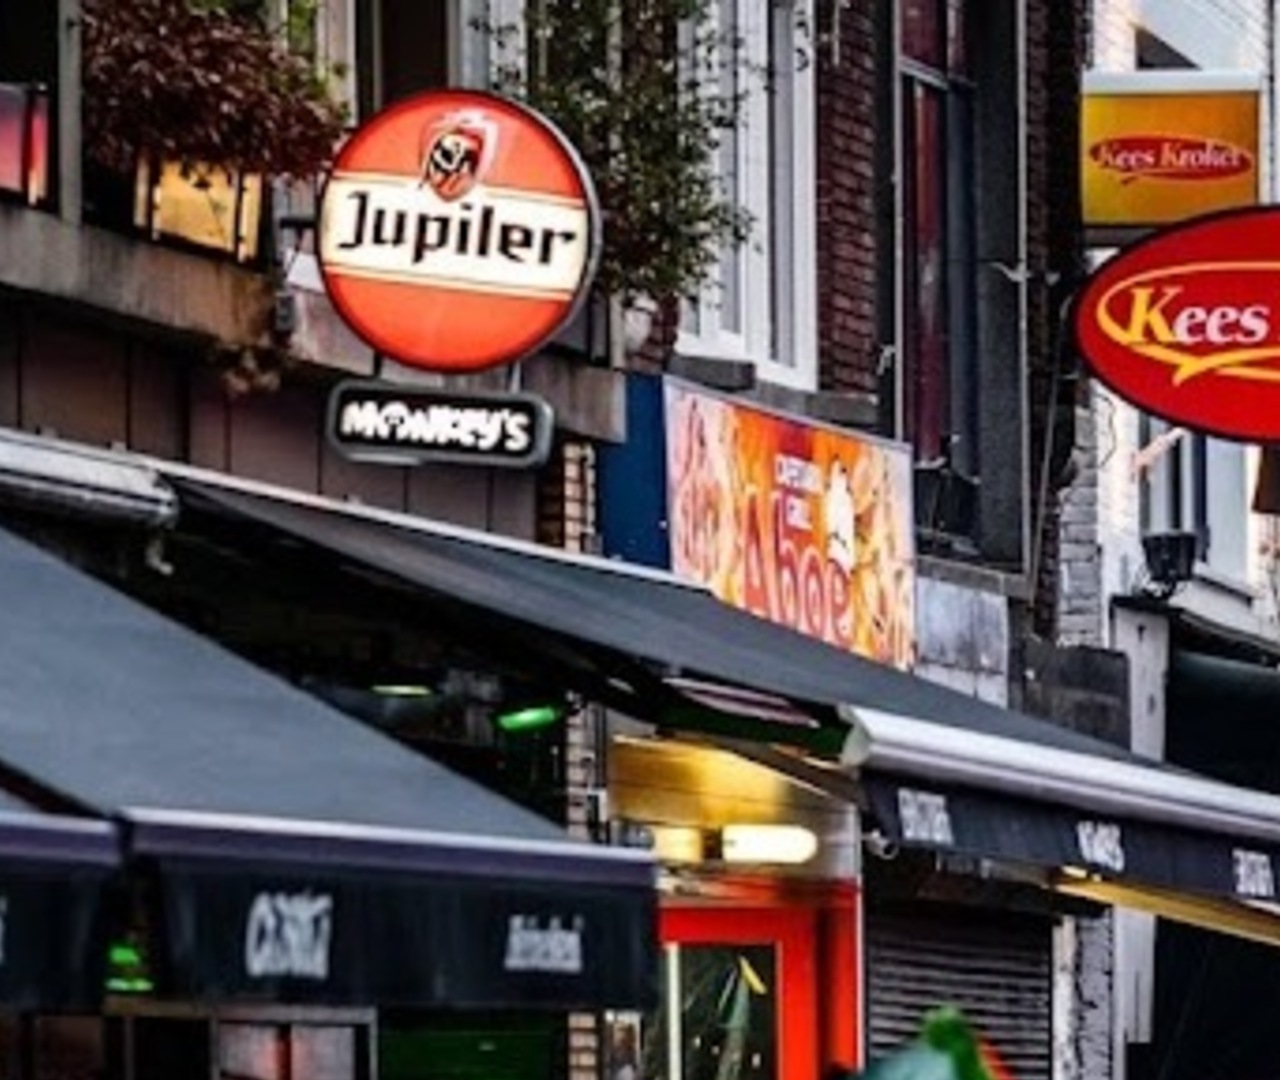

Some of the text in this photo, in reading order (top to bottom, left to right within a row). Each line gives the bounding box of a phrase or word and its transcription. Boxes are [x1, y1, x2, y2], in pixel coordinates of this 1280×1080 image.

[1099, 139, 1241, 169] Kees Kroket
[338, 190, 577, 265] Jupiler
[1126, 284, 1269, 343] Kees
